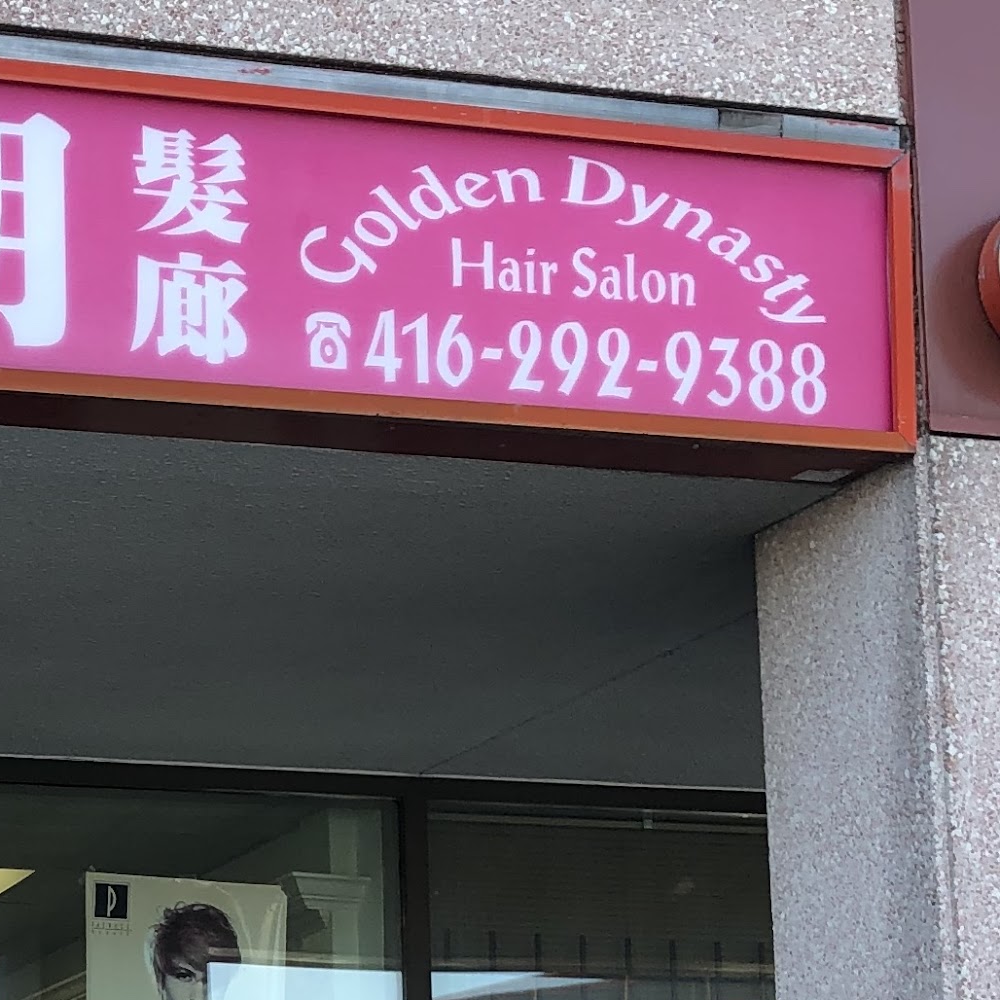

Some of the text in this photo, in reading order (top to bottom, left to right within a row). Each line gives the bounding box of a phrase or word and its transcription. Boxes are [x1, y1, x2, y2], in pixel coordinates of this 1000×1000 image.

[130, 125, 249, 366] 髮廊
[300, 155, 827, 324] Golden Dynasty
[451, 237, 696, 306] Hair Salon
[364, 309, 827, 415] 416-292-9388
